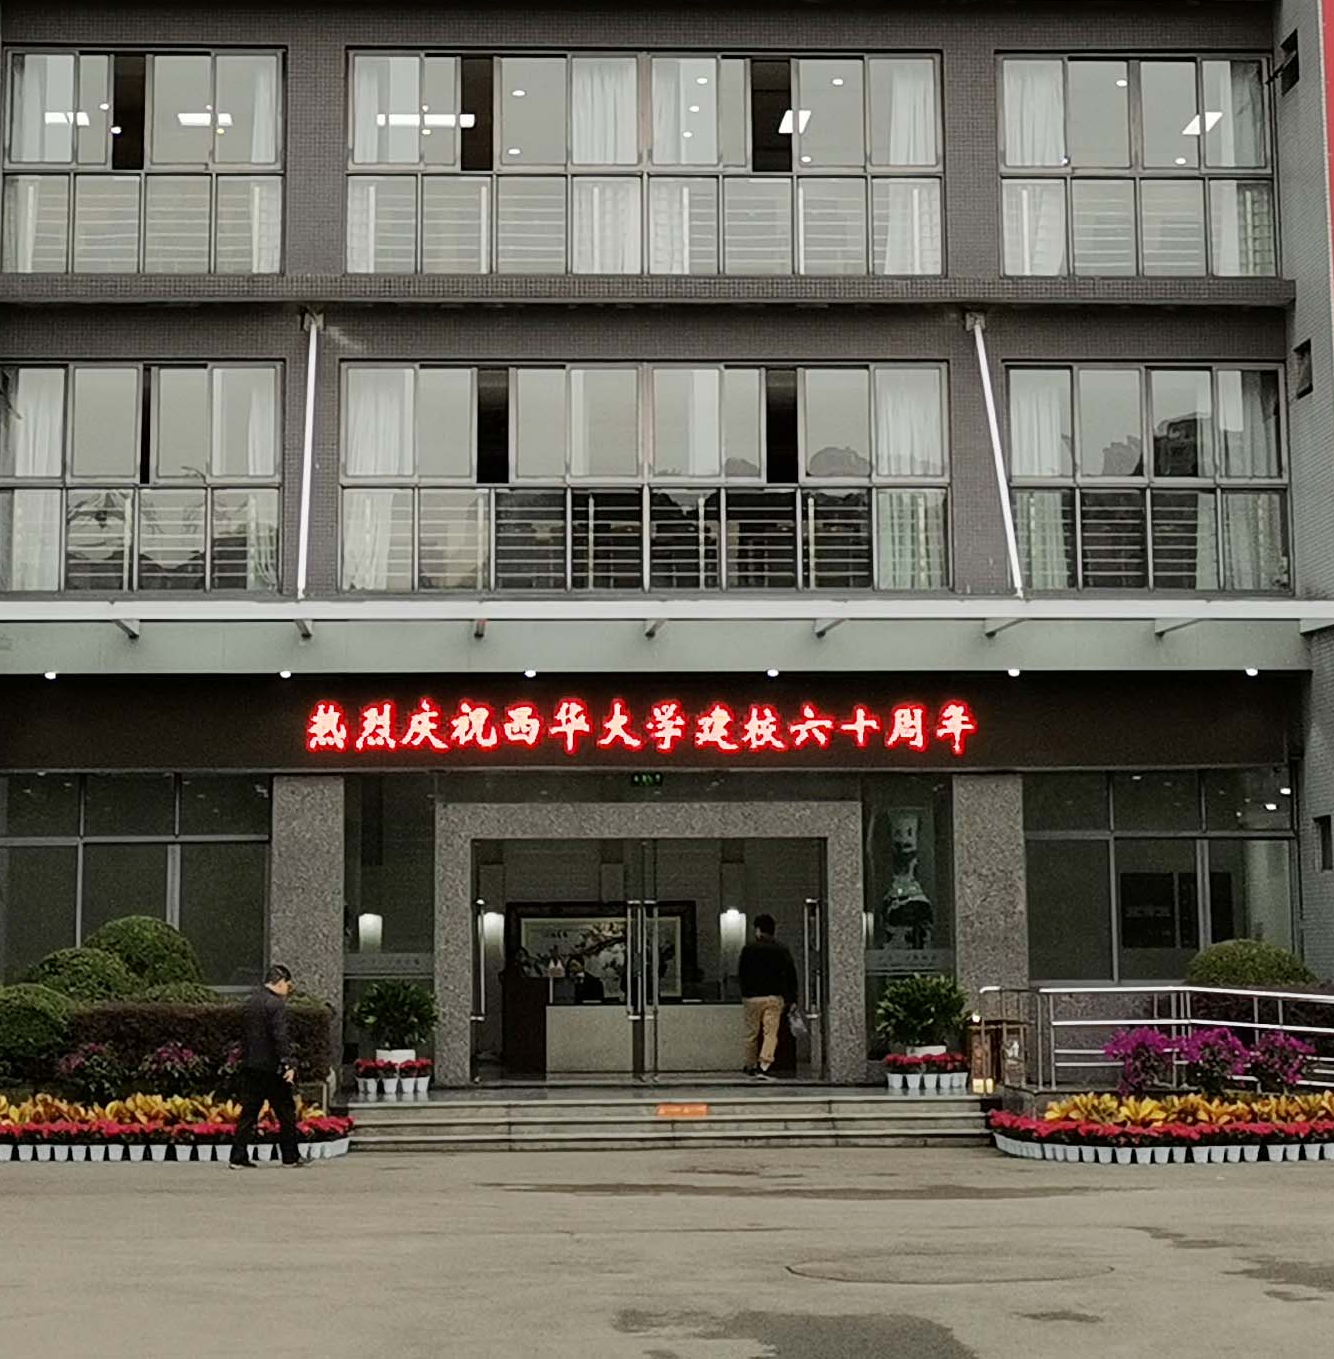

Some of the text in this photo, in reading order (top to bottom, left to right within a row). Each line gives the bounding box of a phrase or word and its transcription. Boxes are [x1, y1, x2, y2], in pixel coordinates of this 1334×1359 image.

[306, 698, 976, 754] 热烈庆祝西华大学建校六十周年
